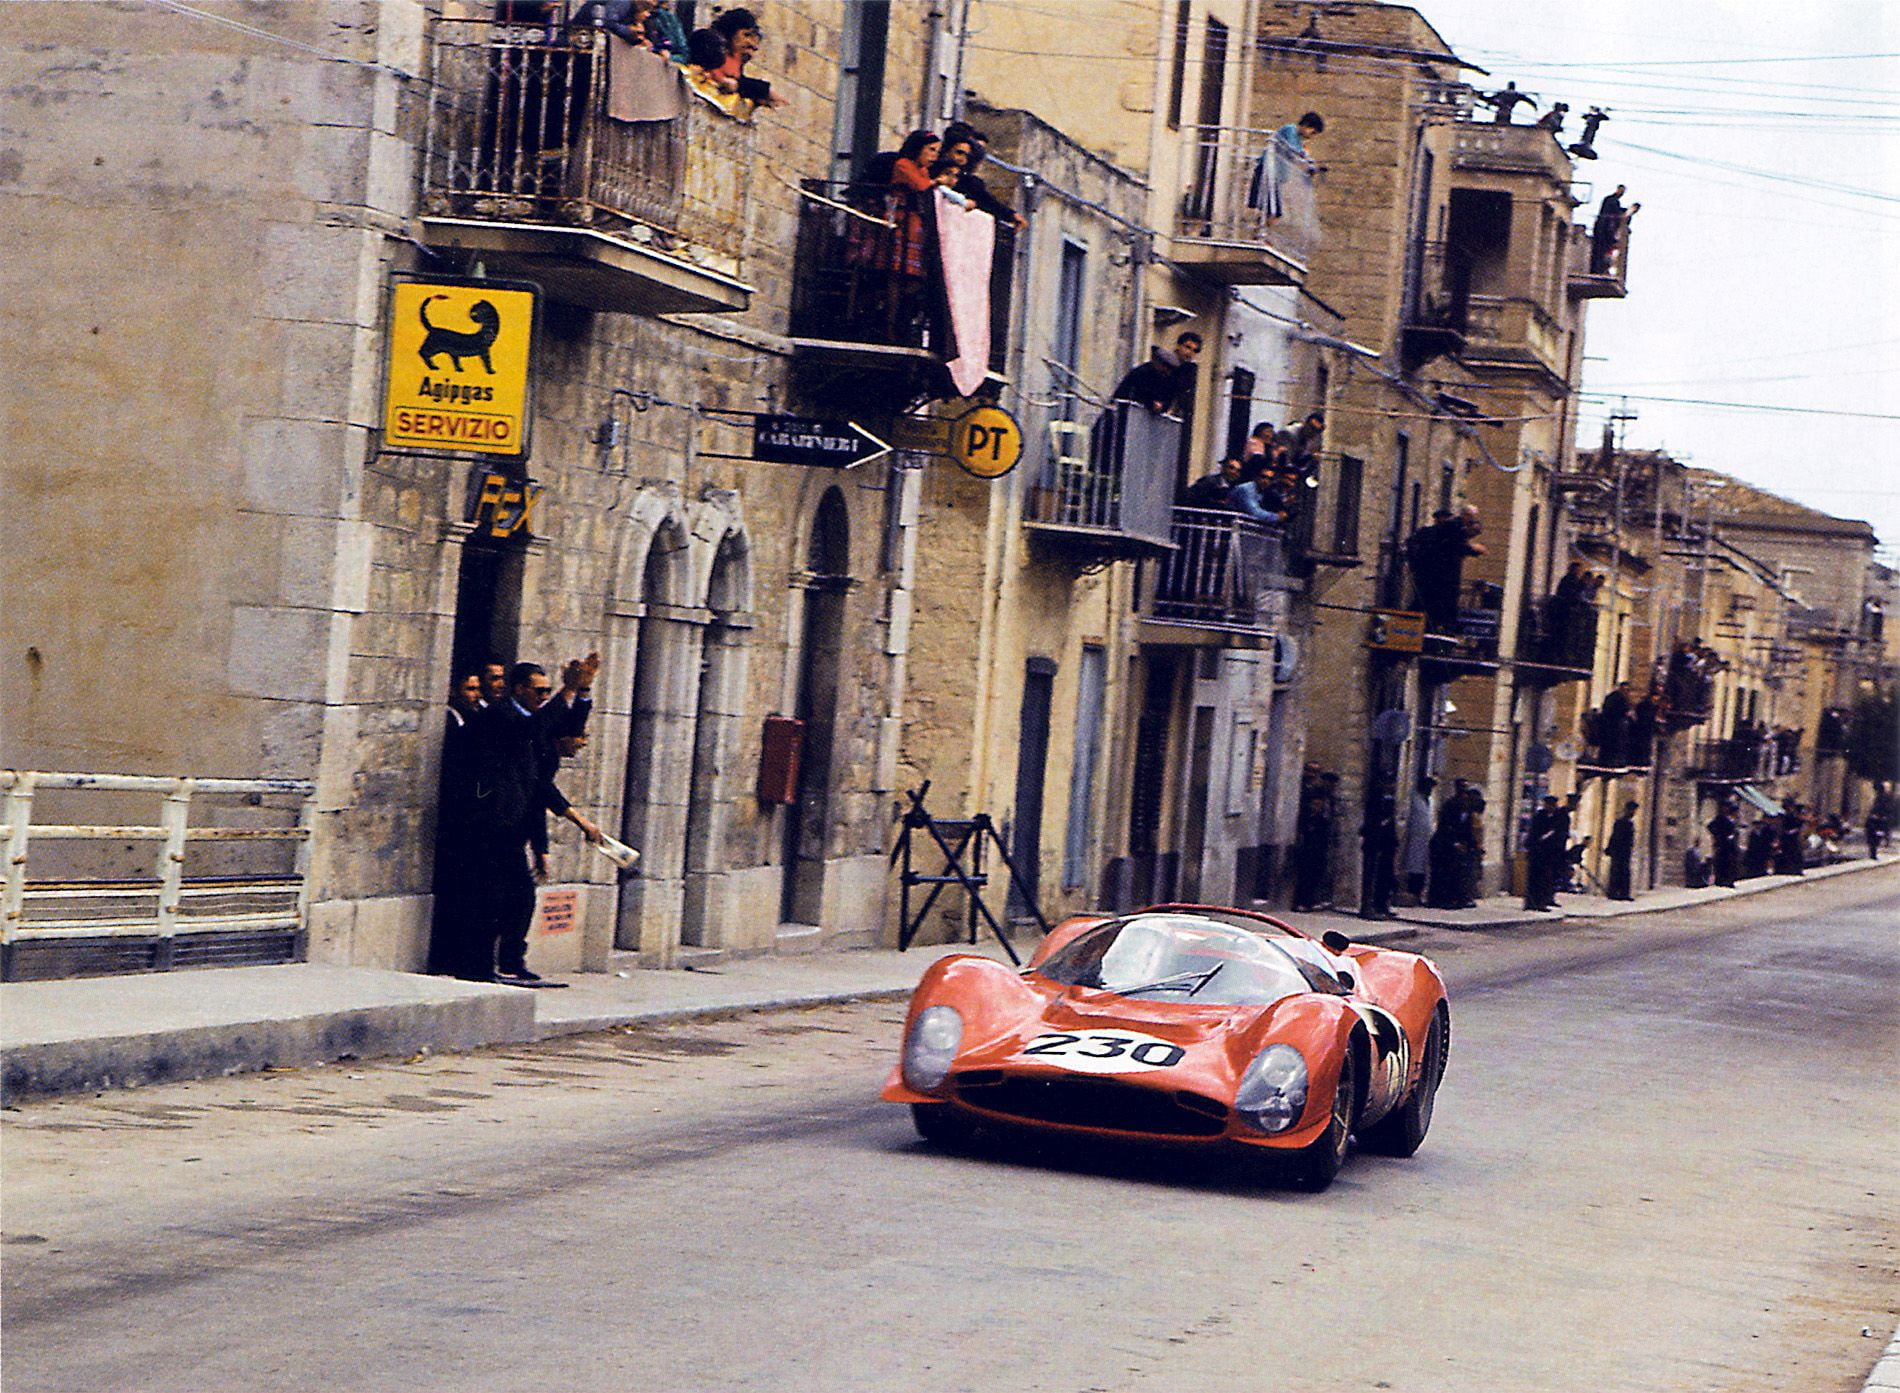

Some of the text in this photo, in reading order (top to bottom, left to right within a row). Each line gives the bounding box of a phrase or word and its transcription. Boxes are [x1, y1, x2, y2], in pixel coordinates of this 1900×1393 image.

[418, 376, 494, 405] Agipgas
[397, 412, 510, 440] SERVIZIO
[966, 423, 1008, 461] PT
[1022, 1033, 1187, 1067] 230
